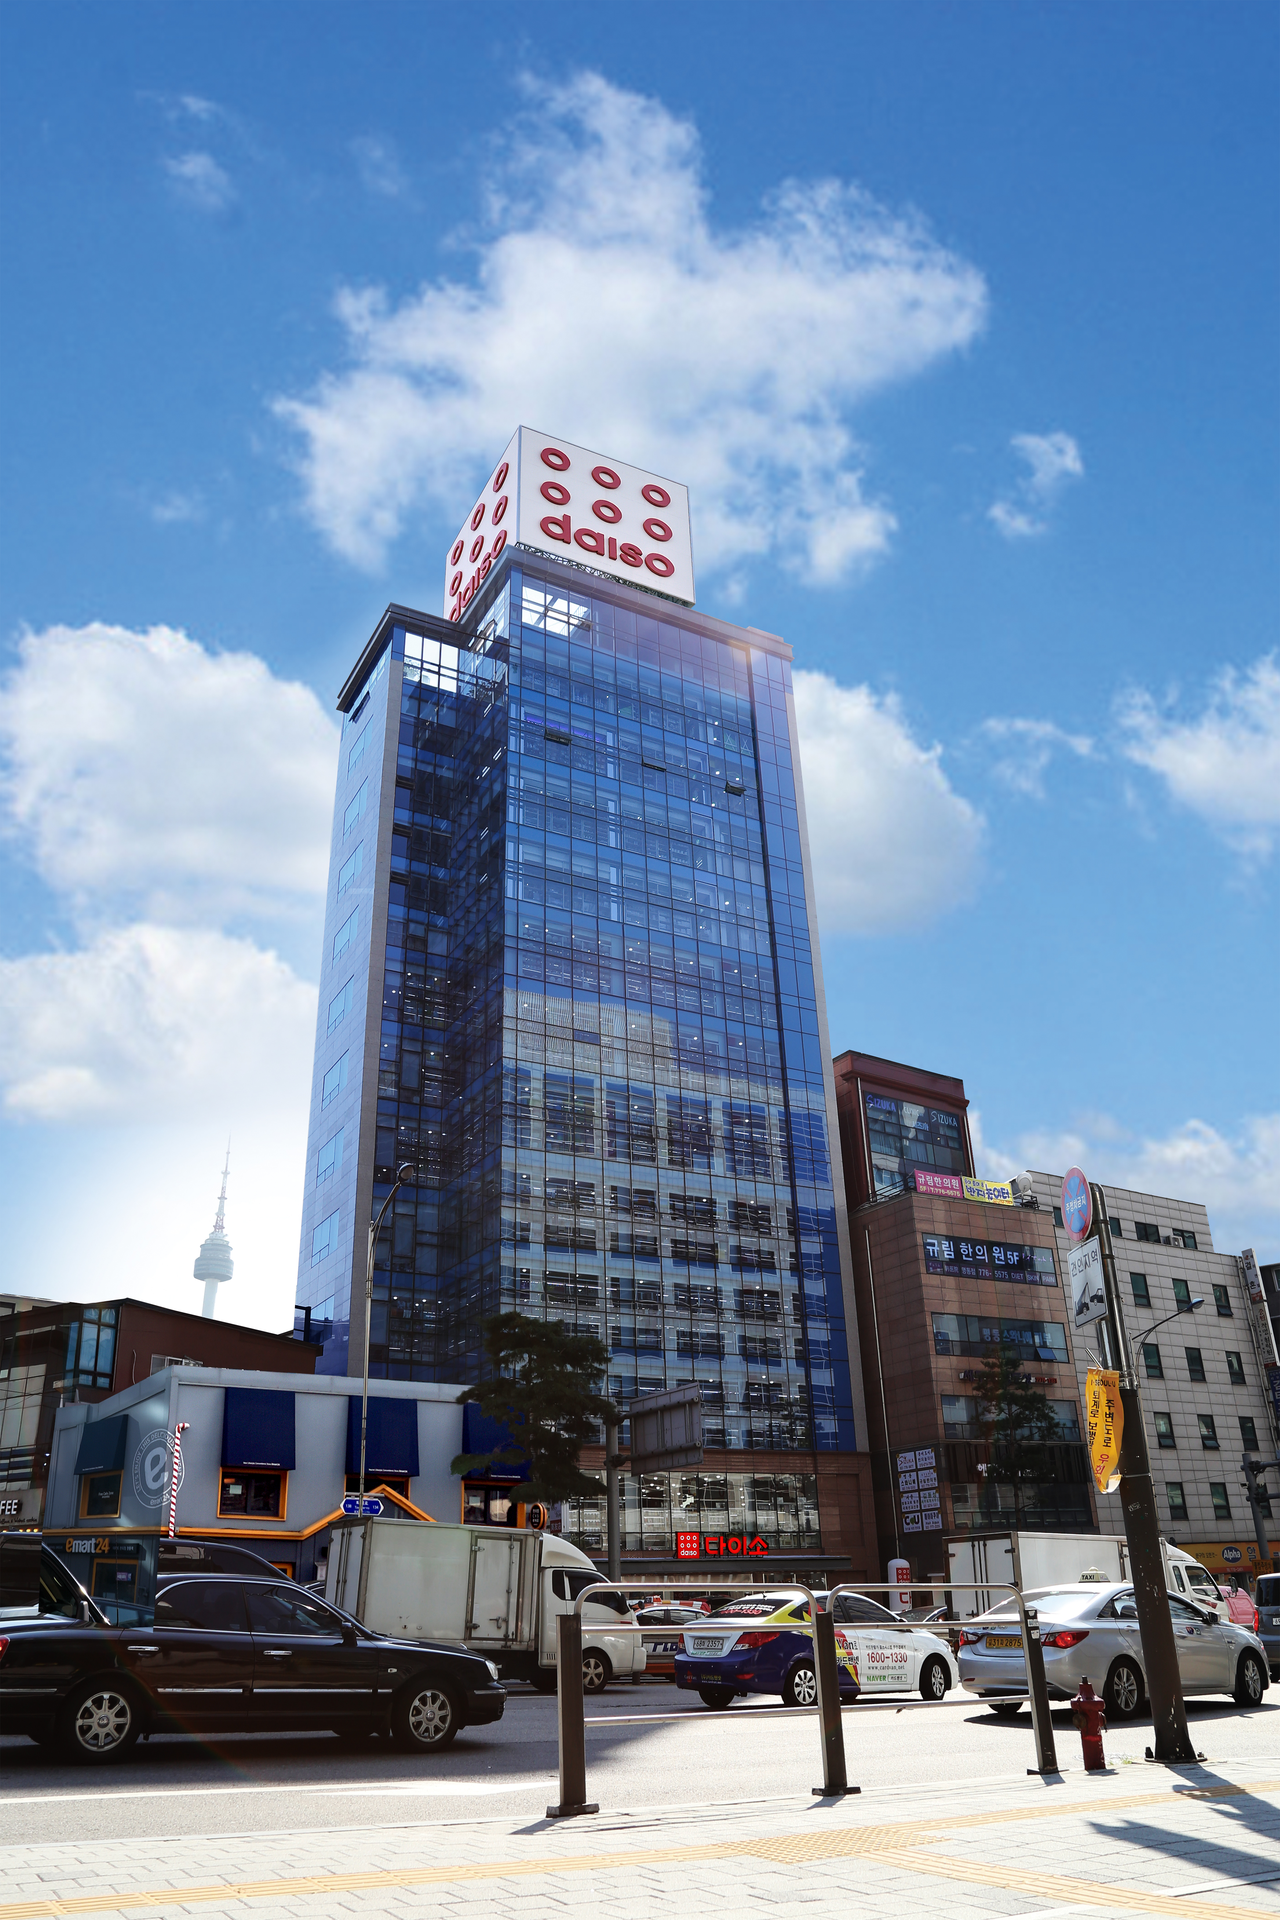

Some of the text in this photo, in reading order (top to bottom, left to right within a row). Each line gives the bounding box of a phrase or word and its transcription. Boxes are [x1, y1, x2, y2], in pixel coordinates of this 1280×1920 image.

[540, 514, 675, 578] daiso
[866, 1094, 897, 1112] SIZUKA
[930, 1111, 958, 1127] SIZUKA
[918, 1173, 960, 1190] 규림한의원
[1065, 1194, 1087, 1214] 주정차금지
[1007, 1251, 1019, 1264] 5F
[1071, 1250, 1099, 1277] 견인지역
[994, 1270, 1009, 1279] 5575
[1090, 1390, 1100, 1419] 퇴계로
[1102, 1399, 1115, 1448] 주변도로
[65, 1537, 110, 1554] emart24
[705, 1535, 769, 1556] 다이소
[1223, 1550, 1241, 1560] Alpha
[707, 1640, 720, 1648] 2357
[835, 1638, 854, 1650] Van
[1005, 1638, 1022, 1647] 2875
[867, 1652, 908, 1663] 1600-1330
